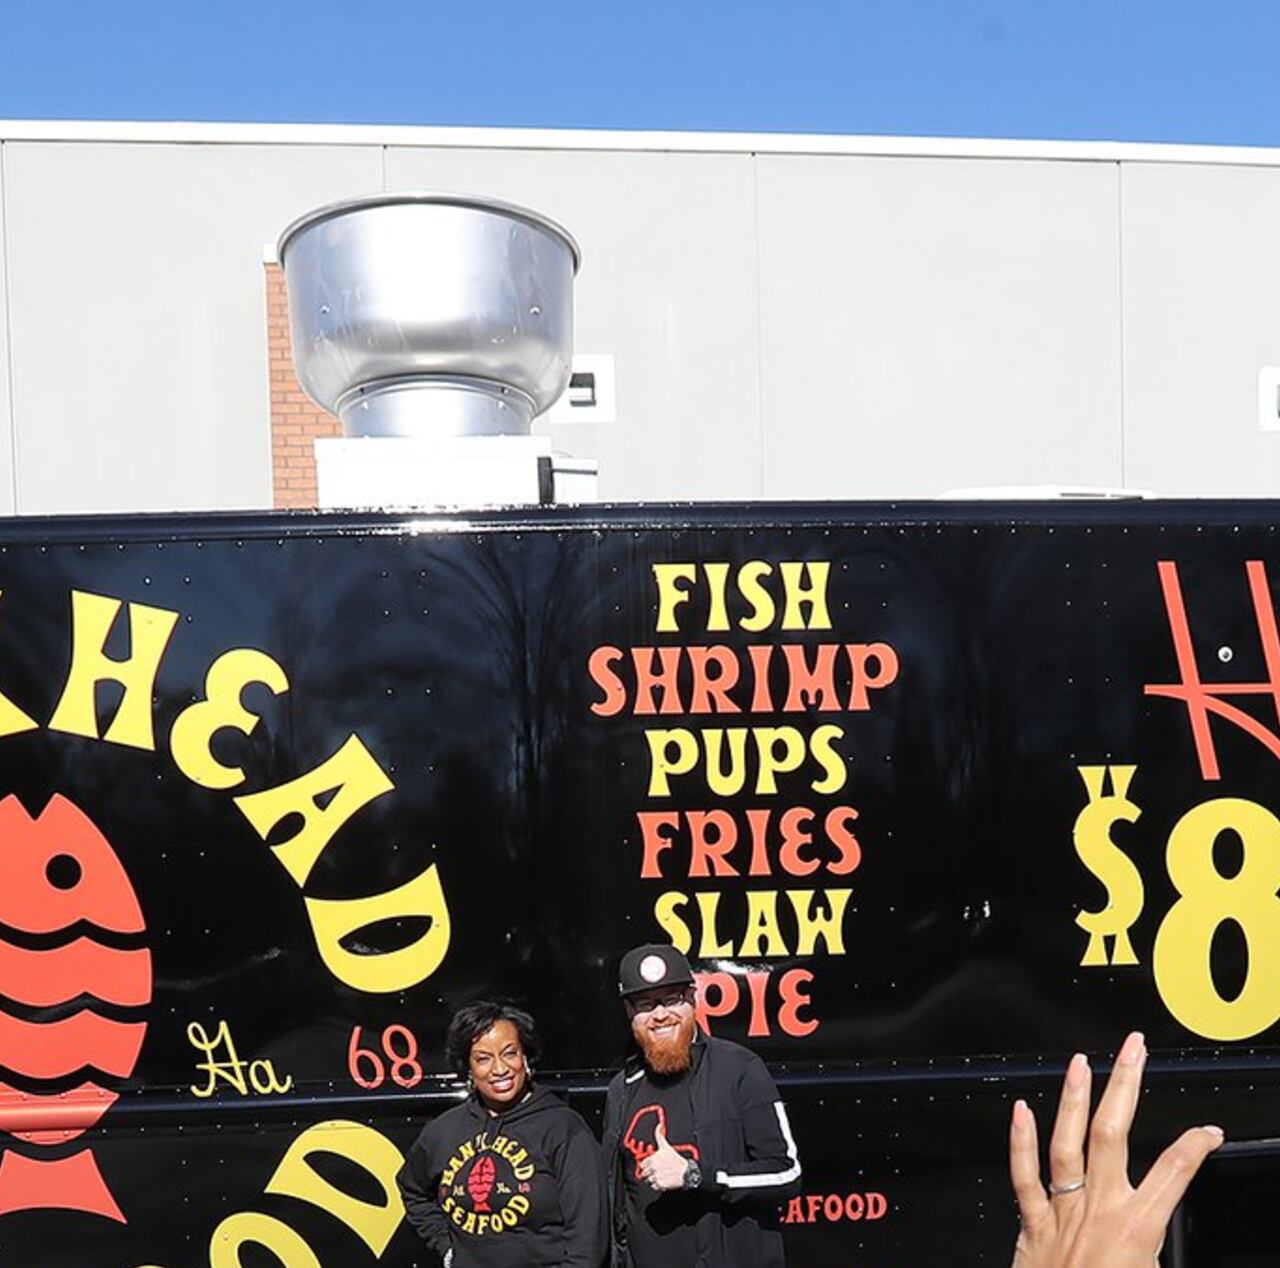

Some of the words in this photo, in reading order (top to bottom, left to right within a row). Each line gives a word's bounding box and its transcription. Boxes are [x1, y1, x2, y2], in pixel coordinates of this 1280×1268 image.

[653, 560, 833, 633] FISH
[587, 642, 900, 717] SHRIMP
[644, 724, 848, 797] PUPS
[636, 806, 863, 879] FRIES
[653, 888, 854, 959] SLAW
[693, 968, 821, 1037] PIE
[348, 1024, 423, 1090] 68
[441, 1195, 531, 1235] SEAFOOD
[779, 1192, 888, 1224] AFOOD
